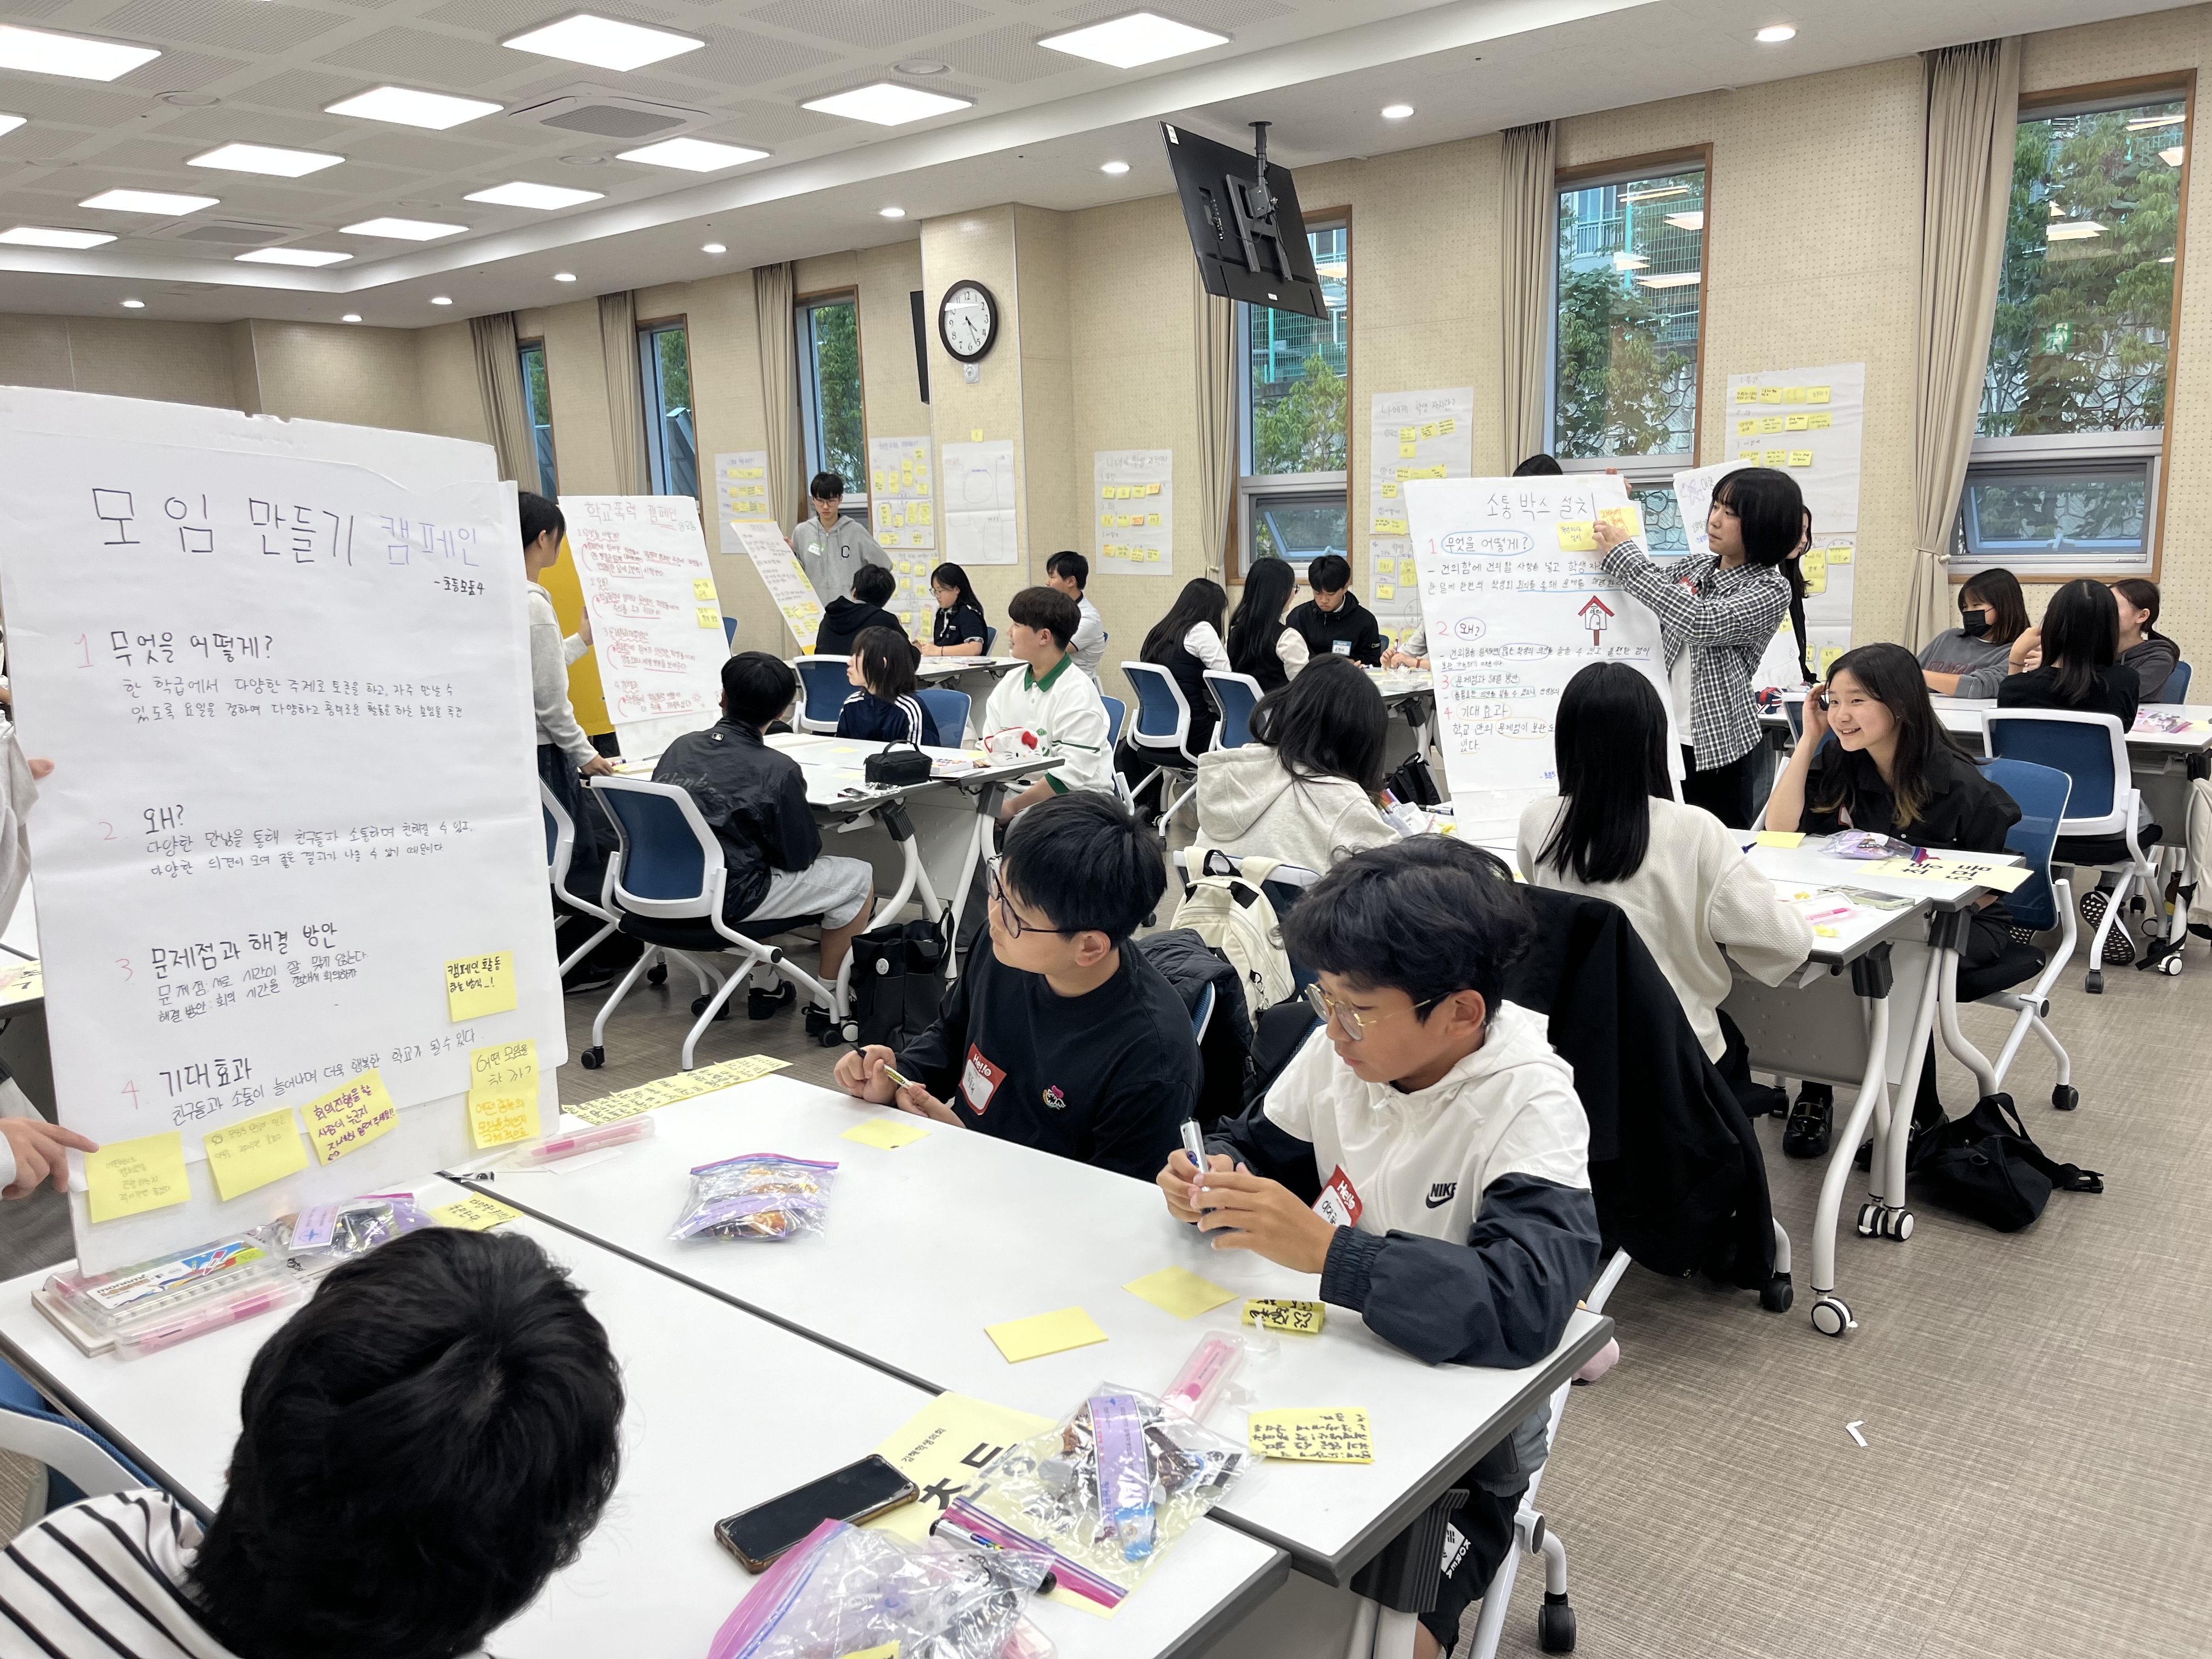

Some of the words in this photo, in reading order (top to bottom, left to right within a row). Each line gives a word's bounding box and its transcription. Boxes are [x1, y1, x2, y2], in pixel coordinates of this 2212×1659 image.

[964, 291, 970, 301] 12
[981, 302, 985, 311] 2
[949, 320, 953, 328] 9
[984, 315, 989, 324] 3
[968, 342, 972, 351] 6
[976, 338, 980, 346] 5
[1381, 404, 1409, 417] 나에게
[1415, 401, 1427, 415] 학생
[584, 501, 636, 524] 학교폭력
[647, 505, 677, 523] 캠페인
[1487, 493, 1511, 520] 소통
[1520, 493, 1551, 521] 박스
[92, 488, 214, 554] 모임
[250, 498, 354, 567] 만들기
[380, 515, 480, 568] 캠페인
[841, 545, 850, 558] C
[1429, 539, 1438, 554] 1
[1445, 537, 1475, 553] 무엇을
[1481, 537, 1528, 554] 어떻게?
[1441, 561, 1481, 575] 건의함에
[1517, 561, 1539, 572] 사항을
[1545, 561, 1561, 573] 넣고
[1568, 560, 1586, 574] 학생
[1429, 582, 1436, 595] 한
[1440, 582, 1455, 594] 달에
[1460, 581, 1483, 592] 한번씩
[1492, 579, 1513, 591] 학생회
[1517, 580, 1536, 590] 회의를
[1562, 579, 1585, 590] 문제를
[1438, 621, 1449, 636] 2
[1460, 623, 1480, 636] 왜?
[76, 633, 94, 668] 1
[111, 631, 175, 664] 무엇을
[190, 633, 273, 663] 어떻게?
[1450, 647, 1475, 659] 건의함을
[1503, 646, 1514, 656] 많은
[1517, 647, 1533, 656] 학생의
[1557, 646, 1571, 656] 들을
[1576, 647, 1583, 657] 수
[1587, 646, 1601, 655] 있고
[1607, 646, 1630, 657] 불편한
[1635, 647, 1651, 657] 점이
[1442, 662, 1453, 670] 보완
[1457, 661, 1477, 669] 가능하기
[122, 678, 142, 698] 한
[153, 676, 218, 696] 학급에서
[234, 678, 281, 695] 다양한
[287, 679, 326, 693] 주제로
[332, 680, 359, 696] 토론을
[366, 682, 388, 697] 하고,
[393, 684, 414, 696] 자주
[421, 684, 441, 697] 만날
[446, 683, 453, 696] 수
[1441, 675, 1449, 689] 3
[1455, 674, 1485, 688] 문제점과
[1488, 674, 1502, 684] 해결
[1505, 673, 1519, 684] 방안
[1455, 690, 1476, 700] 불필요한
[132, 702, 174, 724] 있도록
[185, 702, 215, 718] 요일을
[225, 702, 261, 716] 정하여
[272, 703, 320, 717] 다양하고
[324, 701, 360, 717] 흥미로운
[368, 702, 391, 716] 활동을
[395, 704, 413, 718] 하는
[421, 704, 442, 718] 모임을
[1443, 707, 1452, 719] 4
[1453, 723, 1469, 737] 학교
[1475, 723, 1493, 735] 안의
[1498, 723, 1528, 734] 문제점이
[99, 821, 117, 840] 2
[143, 804, 184, 834] 왜?
[147, 835, 193, 857] 다양한
[205, 829, 244, 848] 만남을
[254, 828, 279, 849] 통해
[294, 829, 339, 848] 친구들과
[349, 825, 394, 843] 소통하며
[402, 822, 428, 837] 친해질
[439, 821, 447, 833] 수
[208, 856, 244, 870] 의견이
[251, 855, 270, 866] 모여
[279, 851, 296, 869] 좋은
[301, 851, 337, 865] 결과가
[345, 850, 361, 862] 나올
[370, 848, 377, 860] 수
[115, 958, 133, 981] 3
[152, 940, 240, 979] 문제점과
[249, 931, 288, 955] 해결
[303, 922, 338, 949] 방안
[212, 974, 234, 989] 서로
[243, 964, 276, 983] 시간이
[287, 960, 301, 976] 잘
[447, 962, 479, 979] 캠페인
[482, 956, 501, 973] 활동
[159, 1008, 183, 1024] 해결
[216, 991, 236, 1007] 회의
[247, 978, 280, 998] 시간을
[292, 972, 320, 988] 정해서
[323, 967, 358, 983] 회의하자
[476, 1052, 500, 1073] 어떤
[504, 1045, 529, 1063] 모임을
[973, 1053, 992, 1077] Hello
[121, 1080, 140, 1109] 4
[172, 1096, 224, 1127] 친구들과
[231, 1084, 265, 1108] 소통이
[273, 1069, 318, 1096] 늘어나며
[324, 1062, 345, 1079] 더욱
[351, 1054, 381, 1075] 행복한
[392, 1043, 423, 1064] 학교가
[360, 1084, 373, 1096] 할
[318, 1118, 345, 1138] 사람이
[346, 1104, 368, 1125] 누군지
[1336, 1180, 1356, 1210] Hello
[1446, 1538, 1471, 1579] KOREA
